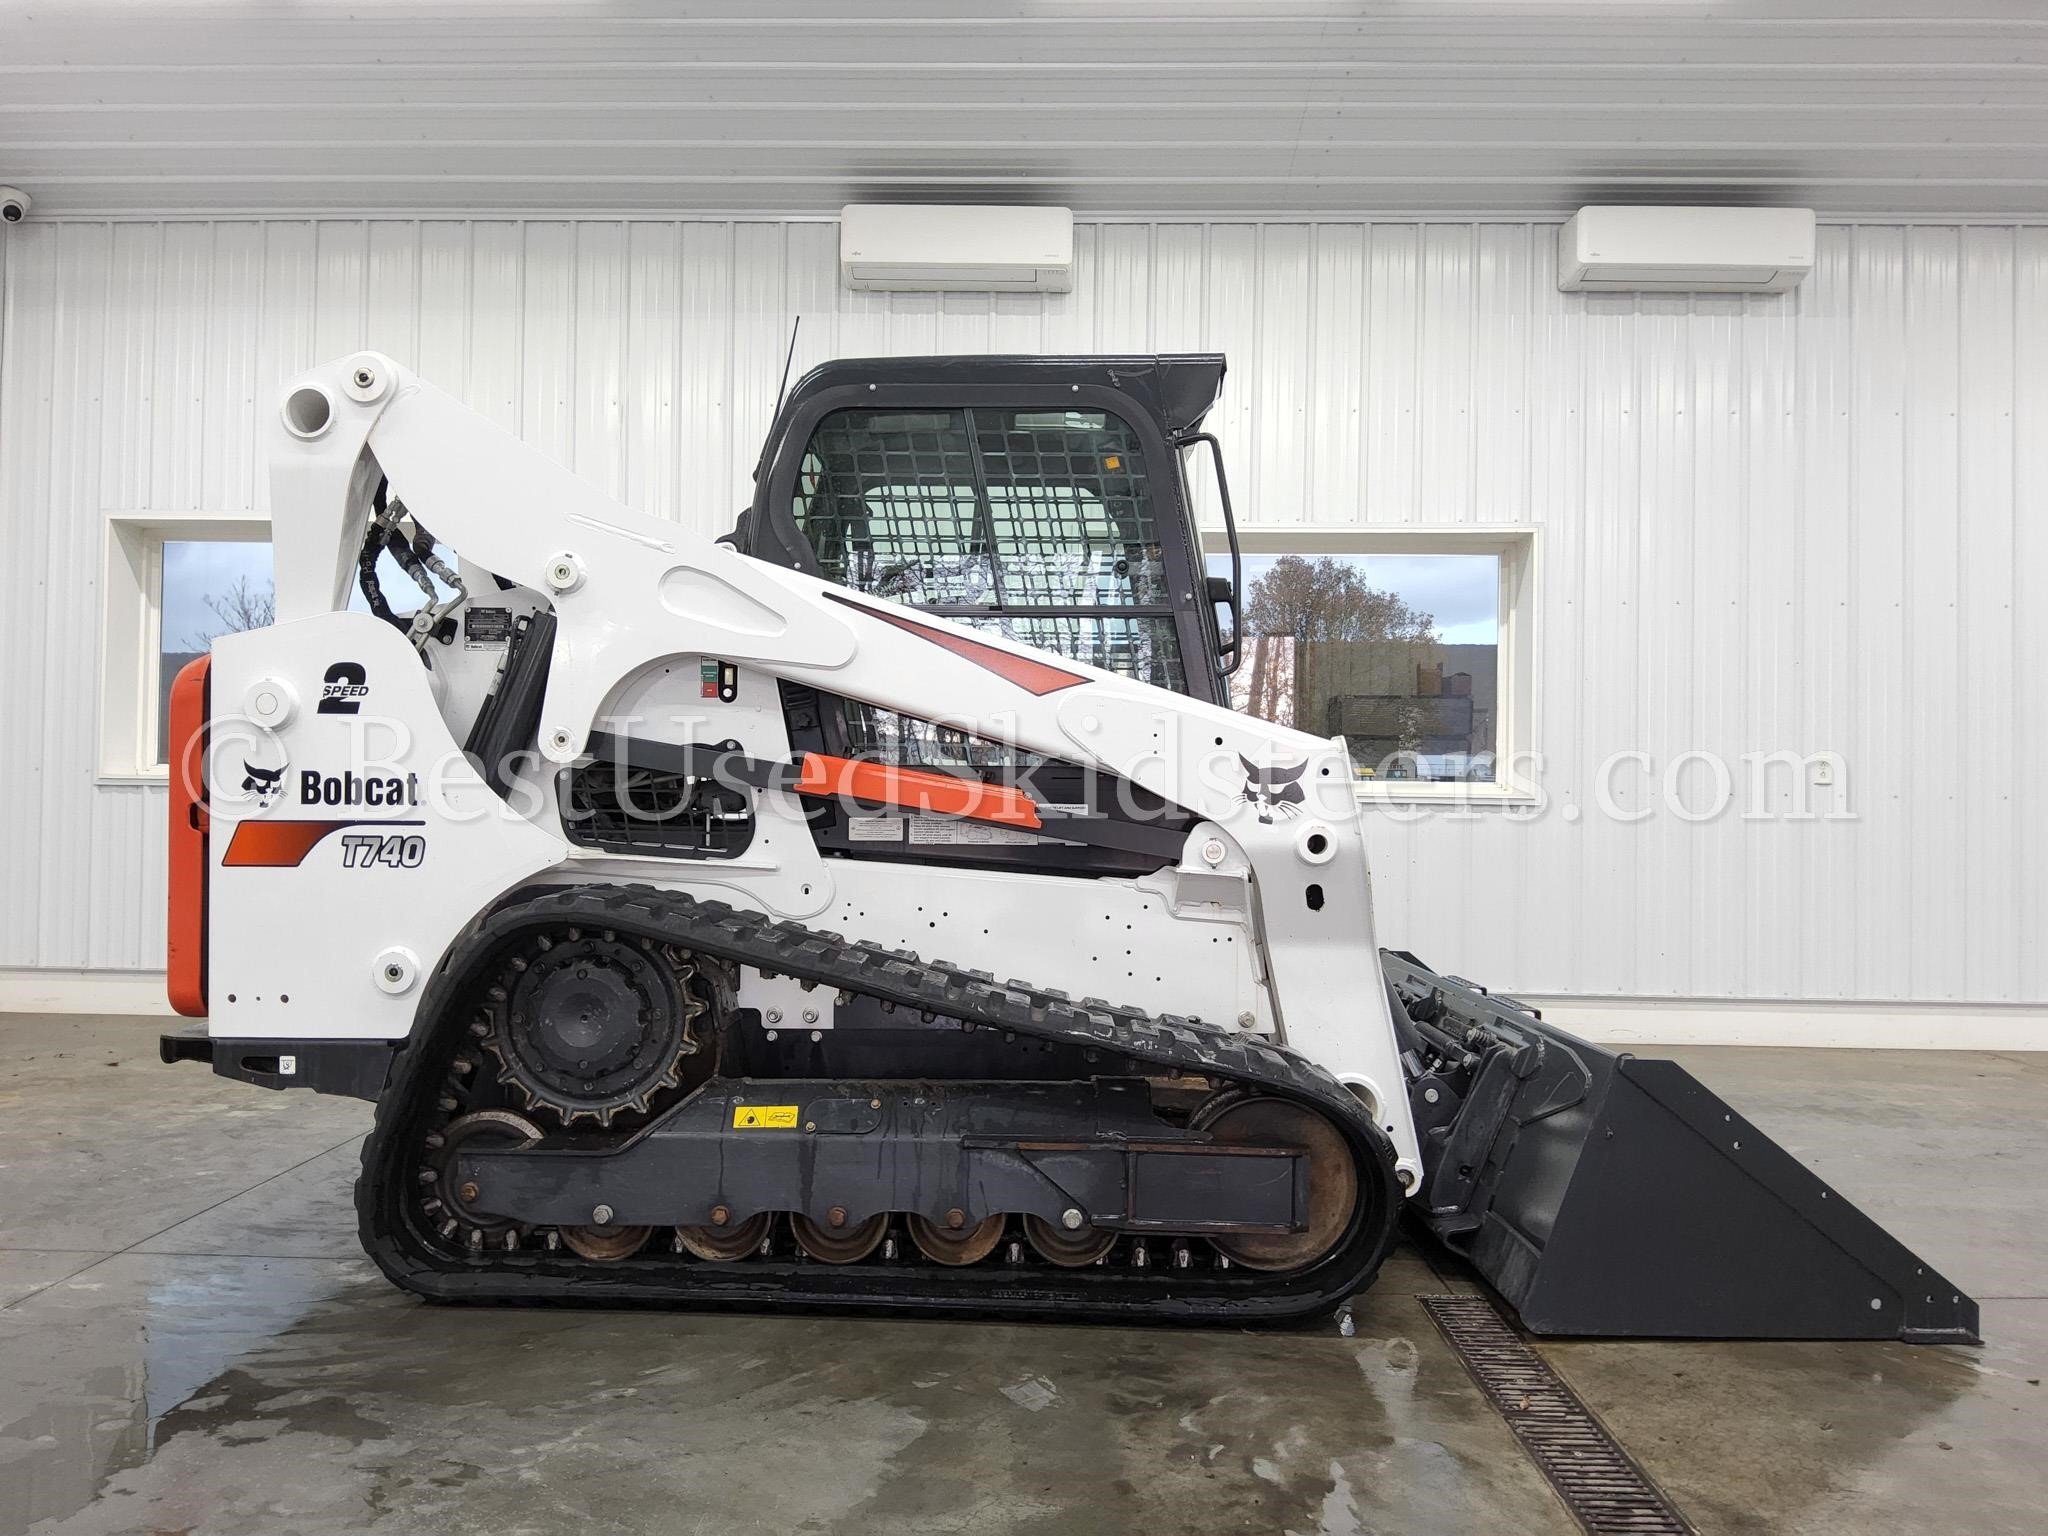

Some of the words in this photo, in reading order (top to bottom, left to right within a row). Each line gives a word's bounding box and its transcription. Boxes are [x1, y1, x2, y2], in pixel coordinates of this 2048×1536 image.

[317, 662, 366, 714] 2
[323, 685, 369, 697] SPEED
[300, 770, 418, 806] Bobcat
[342, 835, 426, 868] T740
